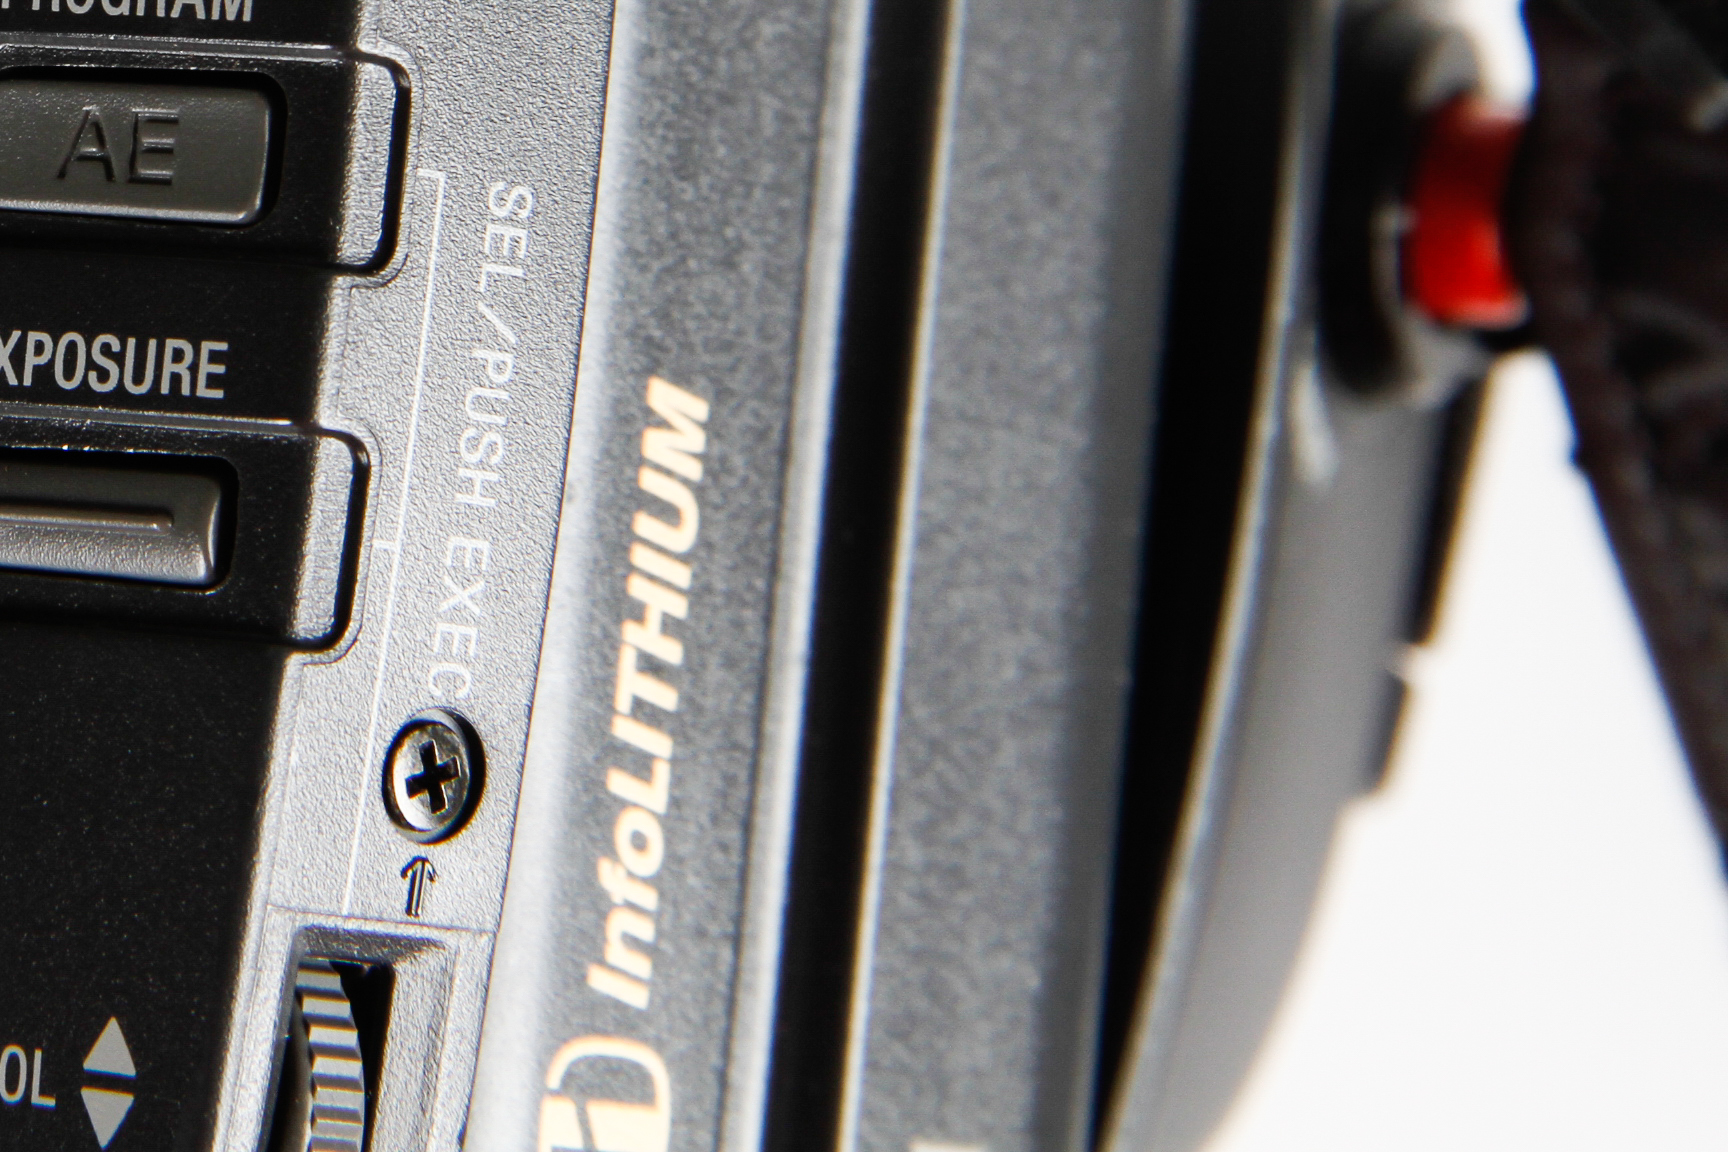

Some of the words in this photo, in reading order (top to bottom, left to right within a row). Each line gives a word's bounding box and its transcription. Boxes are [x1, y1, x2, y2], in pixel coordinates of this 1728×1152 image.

[56, 104, 179, 185] AE
[454, 181, 533, 508] SEL/PUSH
[427, 536, 491, 700] EXEC
[585, 375, 711, 1011] InfoLITHIUM
